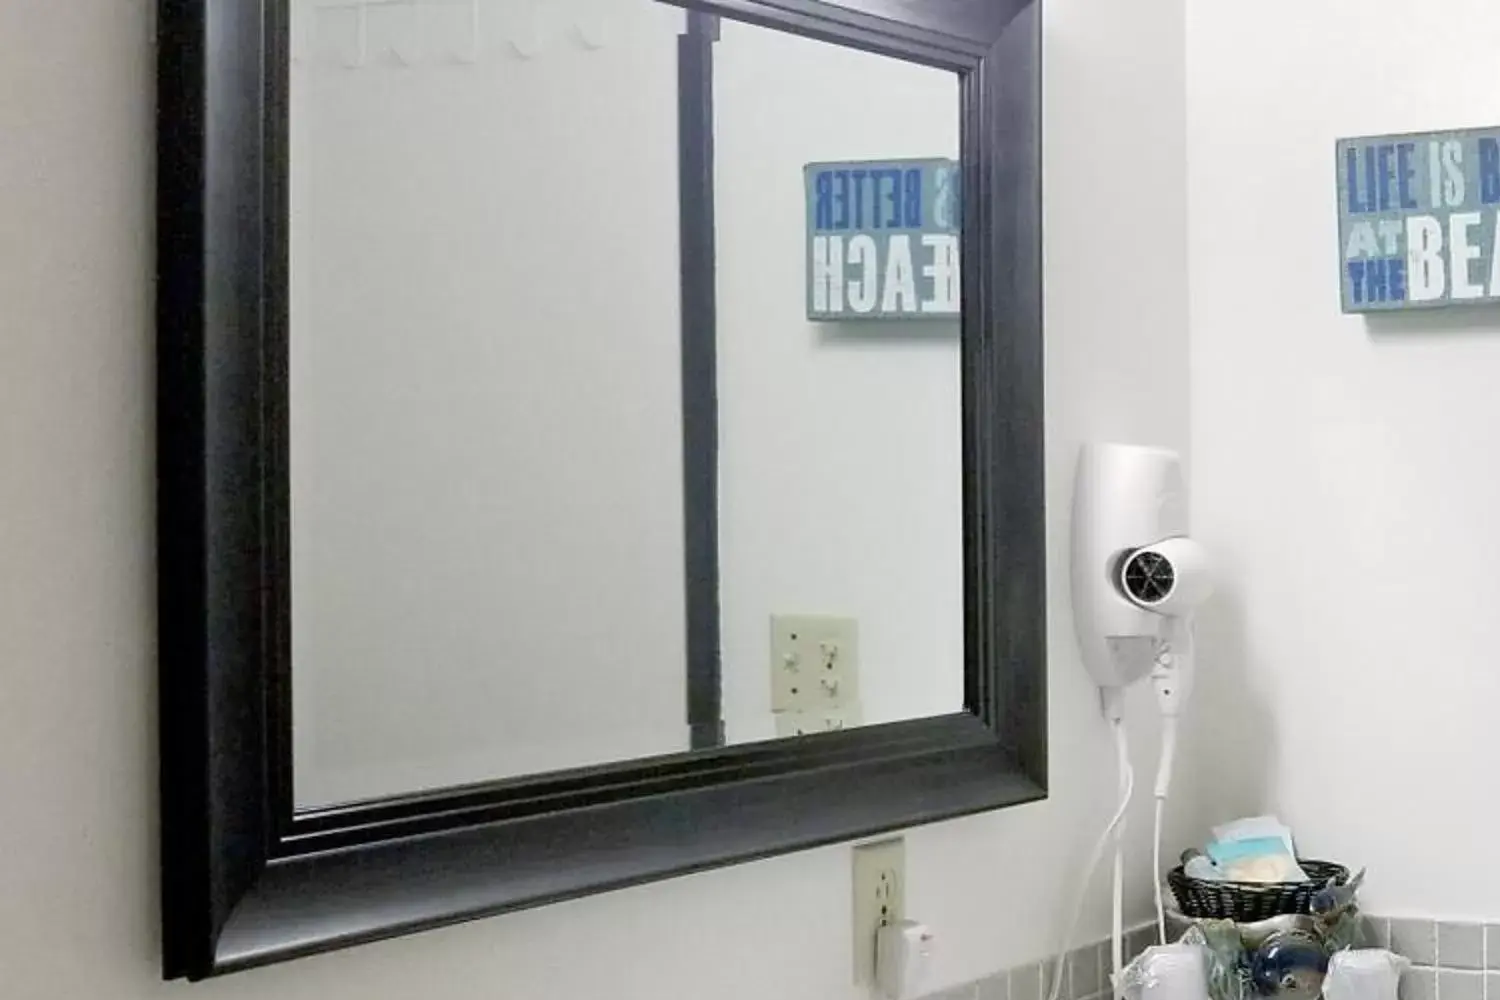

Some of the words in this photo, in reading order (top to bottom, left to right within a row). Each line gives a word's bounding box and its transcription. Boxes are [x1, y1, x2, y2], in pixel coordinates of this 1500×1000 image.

[1347, 143, 1418, 213] LIFE
[1428, 140, 1466, 208] IS
[1345, 219, 1403, 257] AT
[1346, 259, 1406, 305] THE
